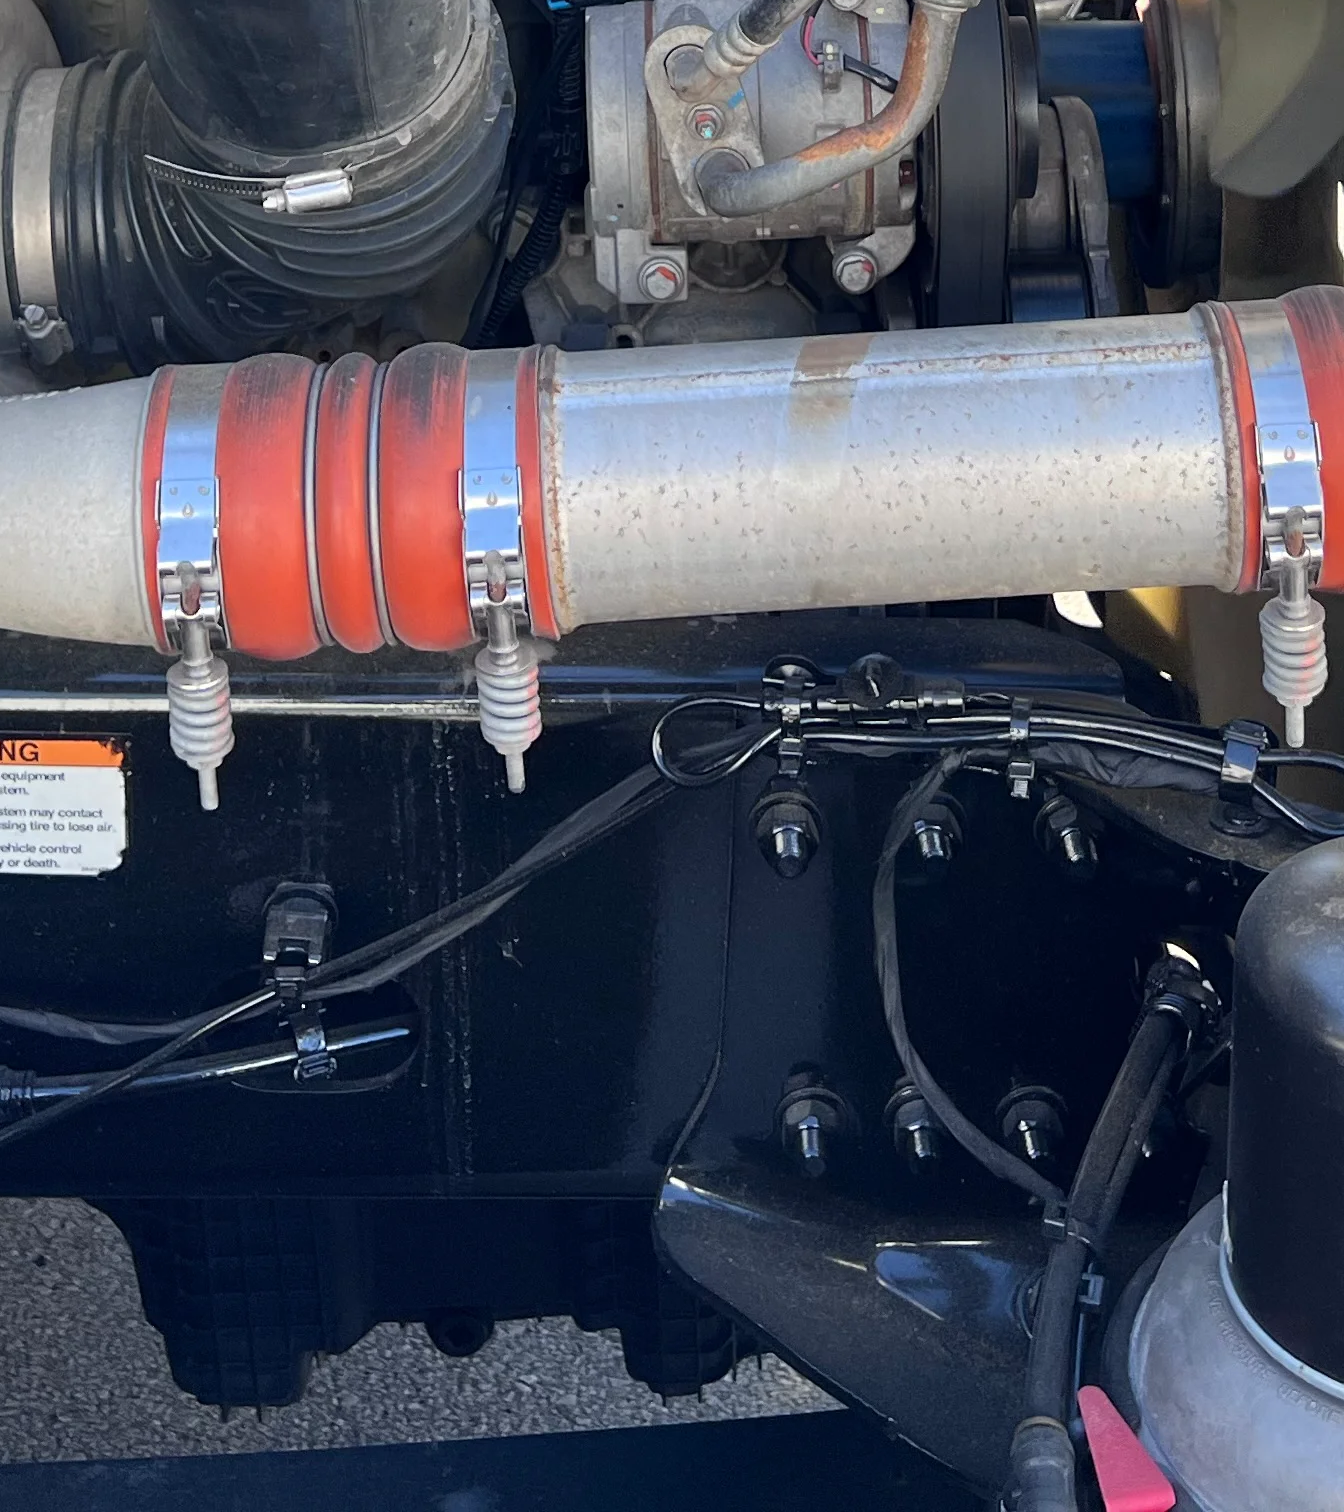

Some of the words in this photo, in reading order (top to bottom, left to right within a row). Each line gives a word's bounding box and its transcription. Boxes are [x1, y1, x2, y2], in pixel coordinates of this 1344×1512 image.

[0, 770, 65, 784] equipment
[29, 808, 55, 820] may
[57, 808, 103, 819] contact
[29, 820, 50, 832] tire
[53, 821, 65, 832] to
[68, 821, 93, 832] lose
[96, 822, 117, 833] air.
[39, 843, 82, 855] control
[7, 858, 20, 868] or
[23, 857, 60, 869] death.
